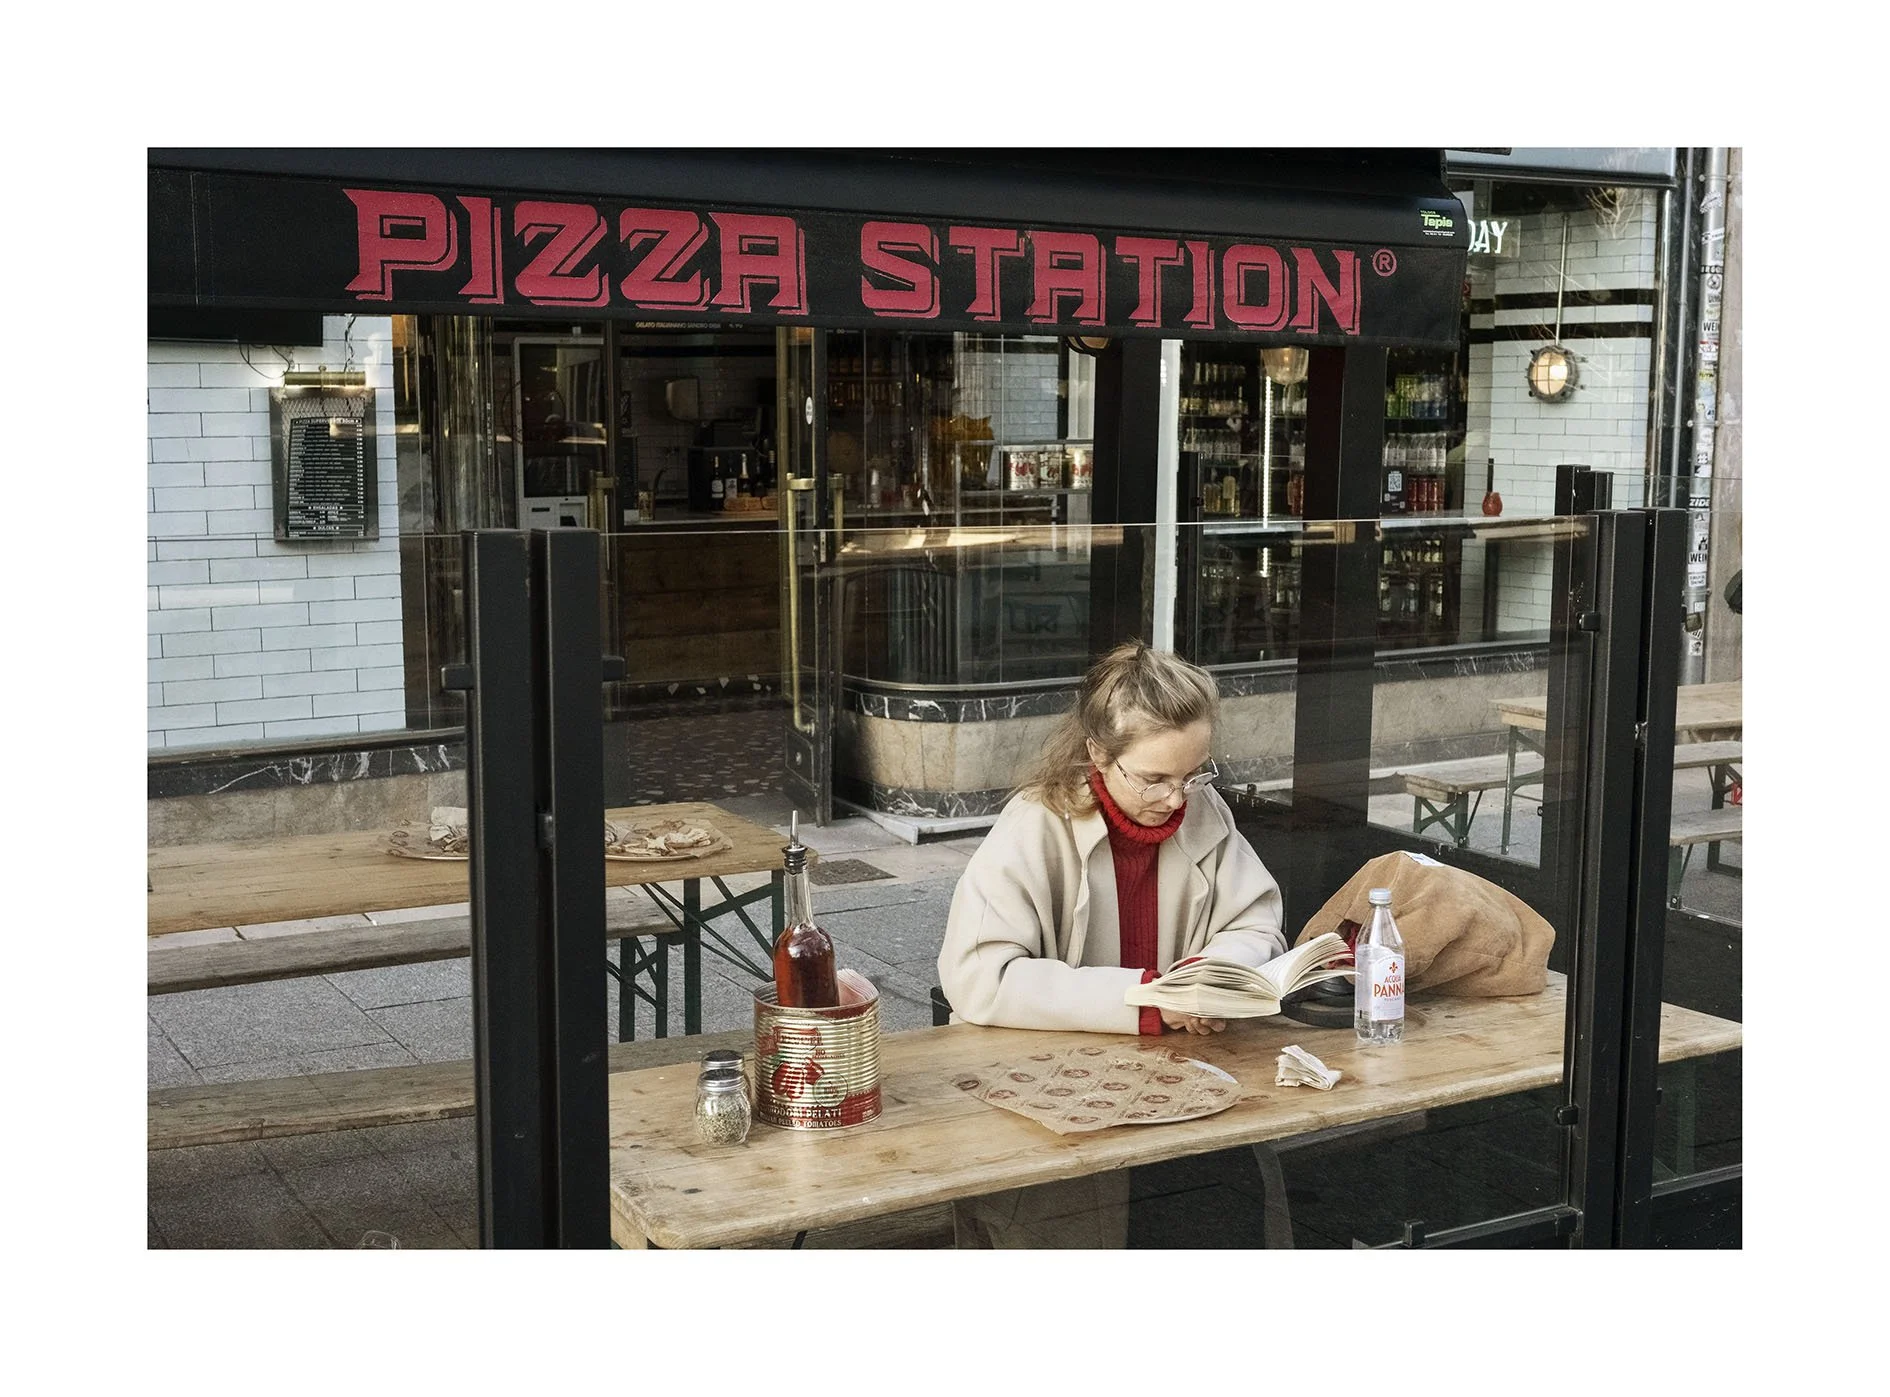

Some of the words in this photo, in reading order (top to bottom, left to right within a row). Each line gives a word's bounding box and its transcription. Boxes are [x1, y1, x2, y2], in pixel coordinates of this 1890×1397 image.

[1421, 214, 1453, 229] Tapia
[343, 188, 809, 315] PIZZA
[861, 220, 1362, 336] STATION
[807, 1109, 841, 1118] PELATI
